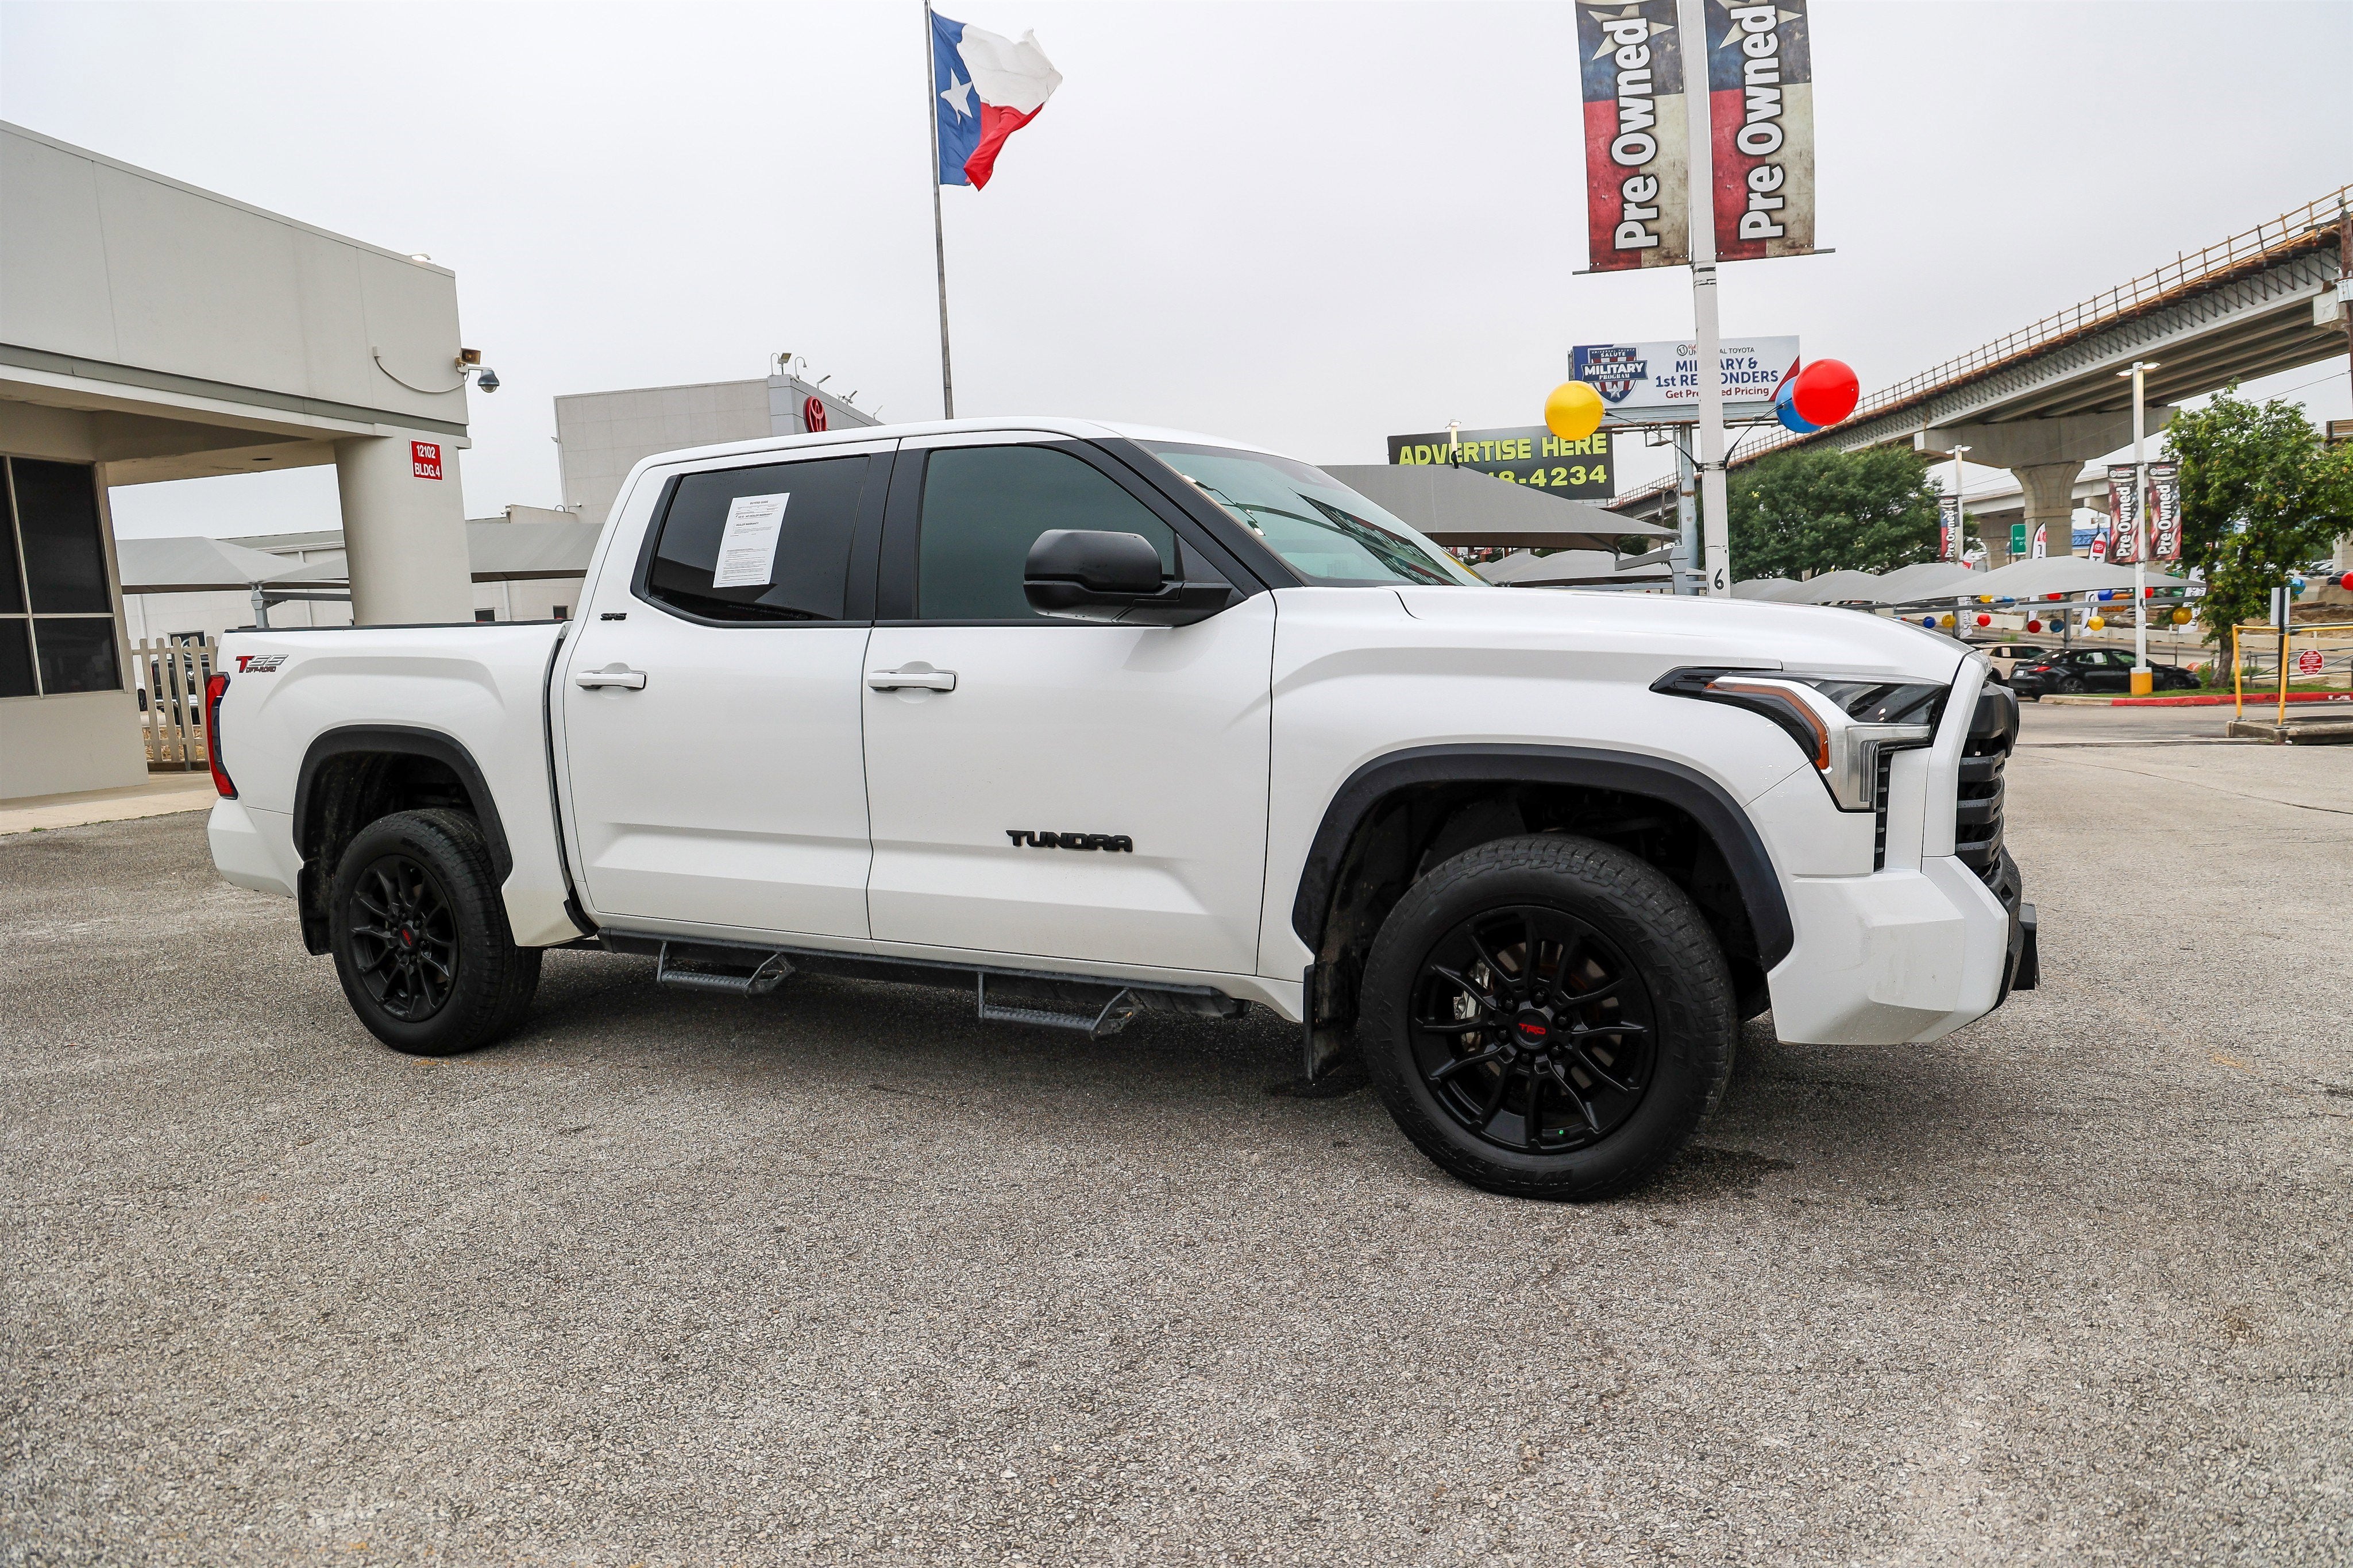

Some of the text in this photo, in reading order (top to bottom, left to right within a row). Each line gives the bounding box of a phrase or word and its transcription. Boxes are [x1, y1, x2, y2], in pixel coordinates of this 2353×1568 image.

[1602, 17, 1659, 250] Pre Owned
[1730, 5, 1784, 240] Pre Owned
[1584, 362, 1644, 376] MILITARY
[1748, 357, 1758, 369] &
[1656, 375, 1676, 388] 1st
[1666, 389, 1683, 399] Get
[1734, 386, 1769, 396] Pricing
[416, 445, 435, 459] 12102
[1399, 433, 1607, 465] ADVERTISE HERE
[2116, 486, 2132, 532] Owned
[2156, 484, 2173, 530] Owned
[2116, 534, 2132, 557] Pre
[2157, 532, 2173, 555] Pre
[1714, 568, 1724, 590] 6
[1005, 829, 1133, 852] TUNDRA
[1518, 1022, 1547, 1035] TRD
